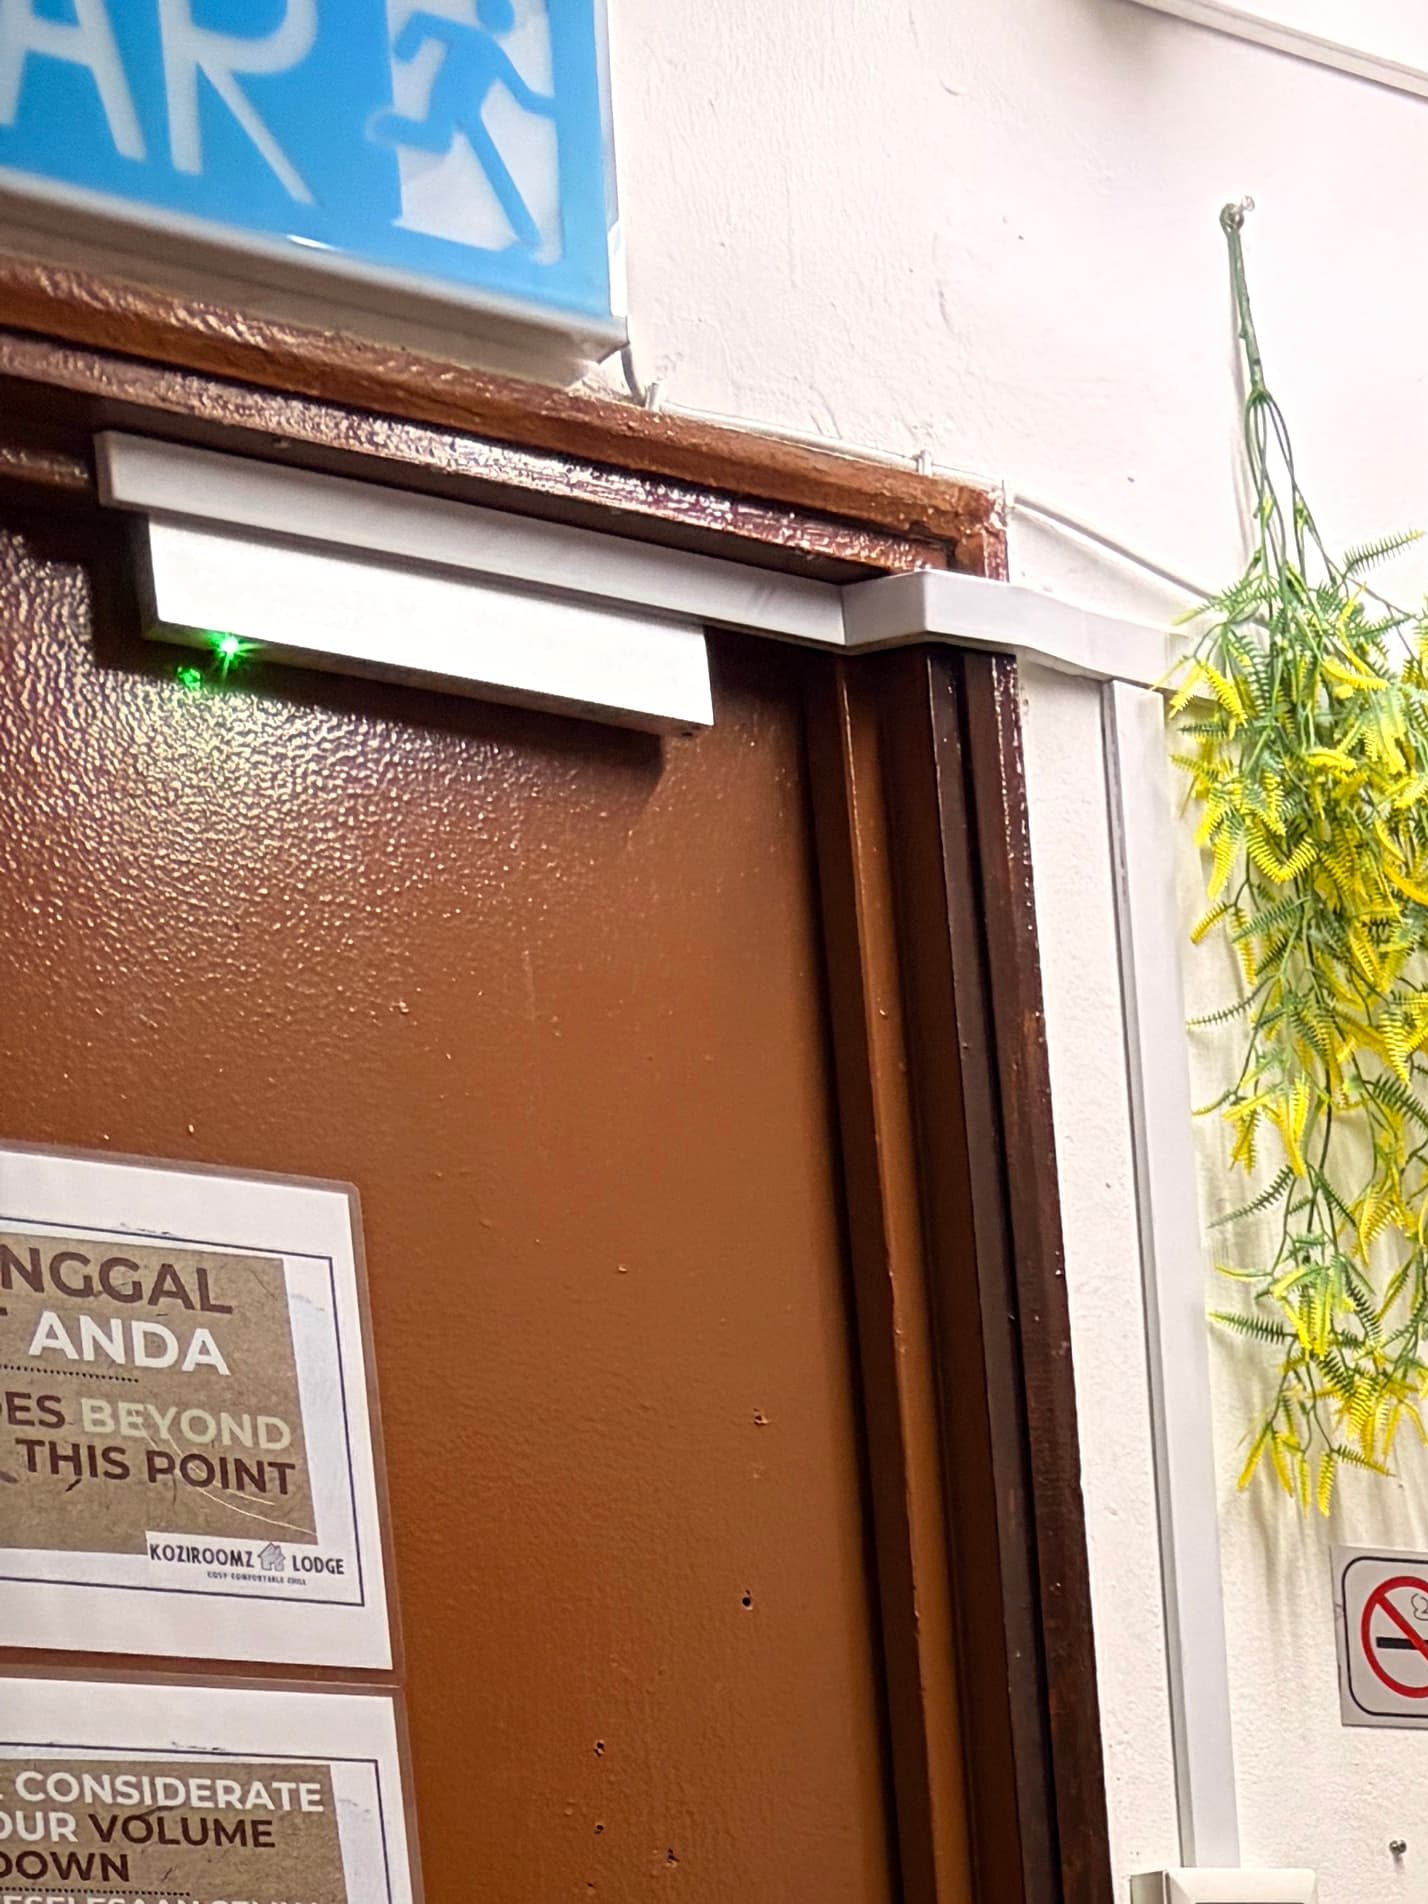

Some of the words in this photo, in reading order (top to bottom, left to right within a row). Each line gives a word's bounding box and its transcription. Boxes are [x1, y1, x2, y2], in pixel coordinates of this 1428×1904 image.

[0, 1243, 233, 1315] NGGAL
[28, 1310, 231, 1376] ANDA
[0, 1390, 66, 1429] ES
[80, 1398, 292, 1451] BEYOND
[15, 1436, 131, 1481] THIS
[146, 1450, 297, 1496] POINT
[150, 1543, 254, 1569] KOZIROOMZ
[292, 1555, 345, 1575] LODGE
[15, 1771, 324, 1813] CONSIDERATE
[88, 1814, 276, 1849] VOLUME
